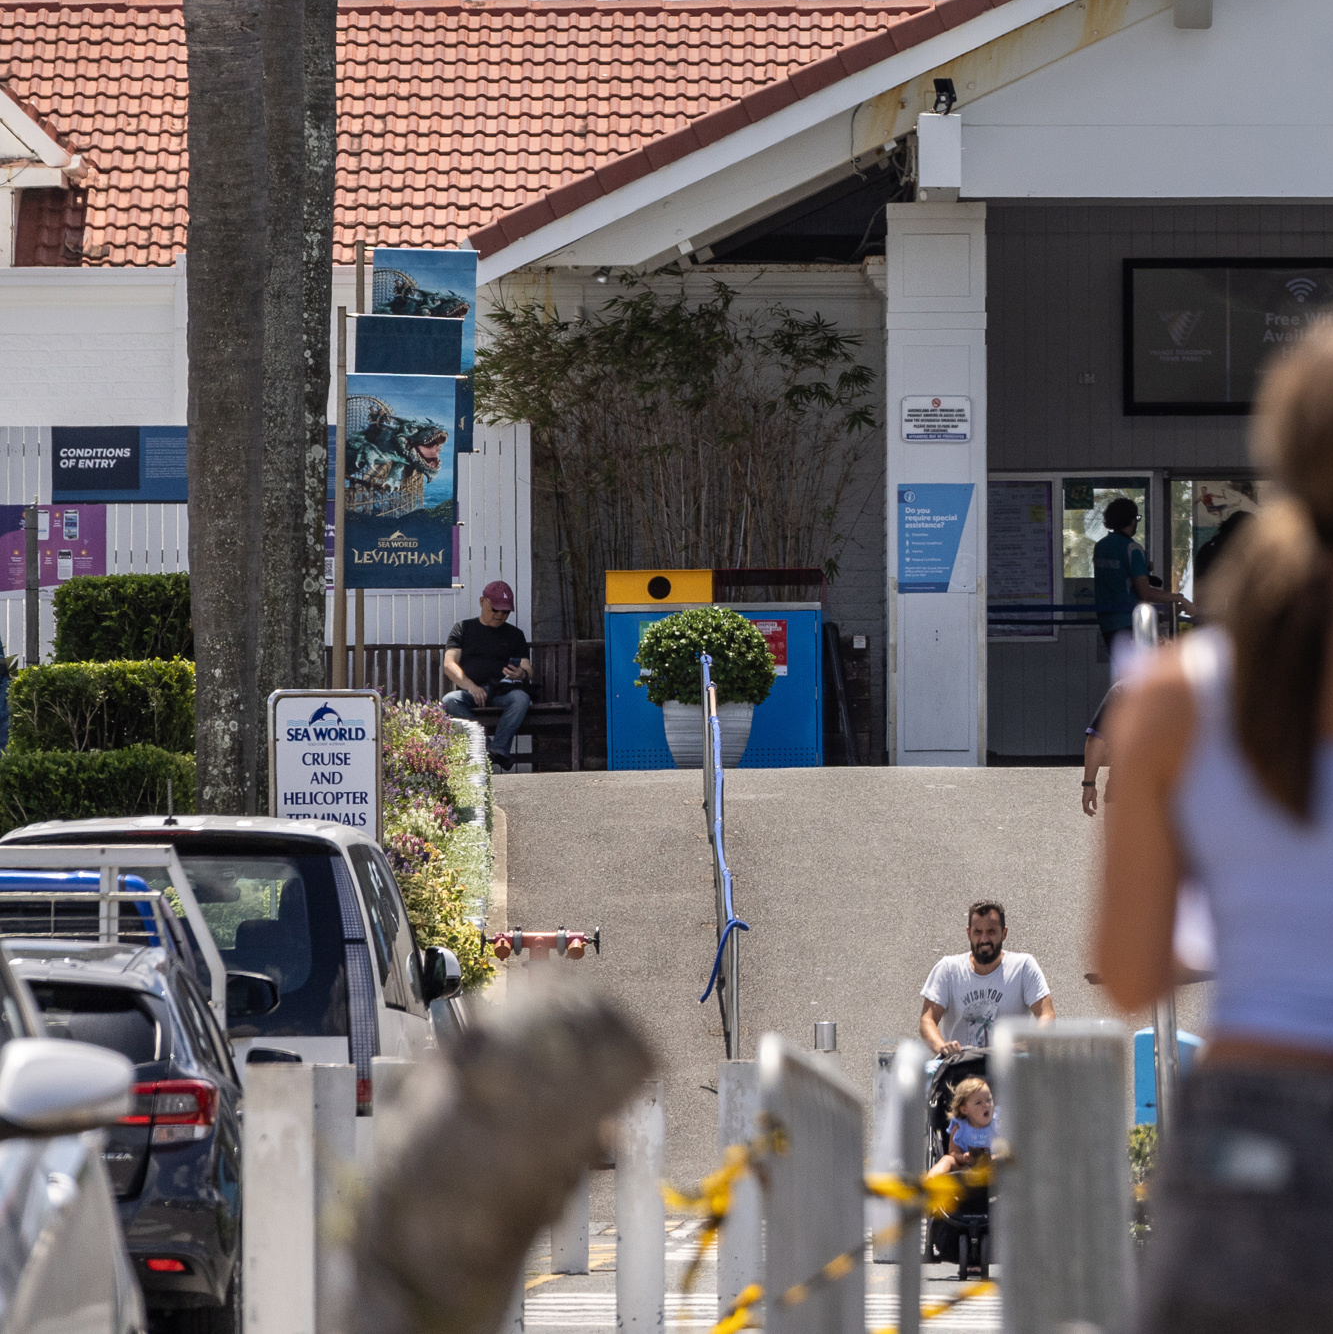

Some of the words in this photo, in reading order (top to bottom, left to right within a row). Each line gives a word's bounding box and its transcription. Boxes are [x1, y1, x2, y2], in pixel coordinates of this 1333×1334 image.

[1265, 312, 1300, 326] Free
[59, 448, 131, 457] CONDITIONS
[59, 459, 77, 468] OF
[77, 459, 117, 468] ENTRY
[904, 515, 932, 524] require
[932, 514, 958, 523] special
[904, 521, 945, 529] assistance?
[351, 548, 445, 567] LEVIATHAN
[286, 727, 312, 742] SEA
[313, 727, 366, 742] WORLD
[301, 752, 351, 766] CRUISE
[310, 771, 343, 785] AND
[283, 791, 369, 806] HELICOPTER
[962, 989, 985, 1006] WISH
[987, 988, 1003, 1003] YOU
